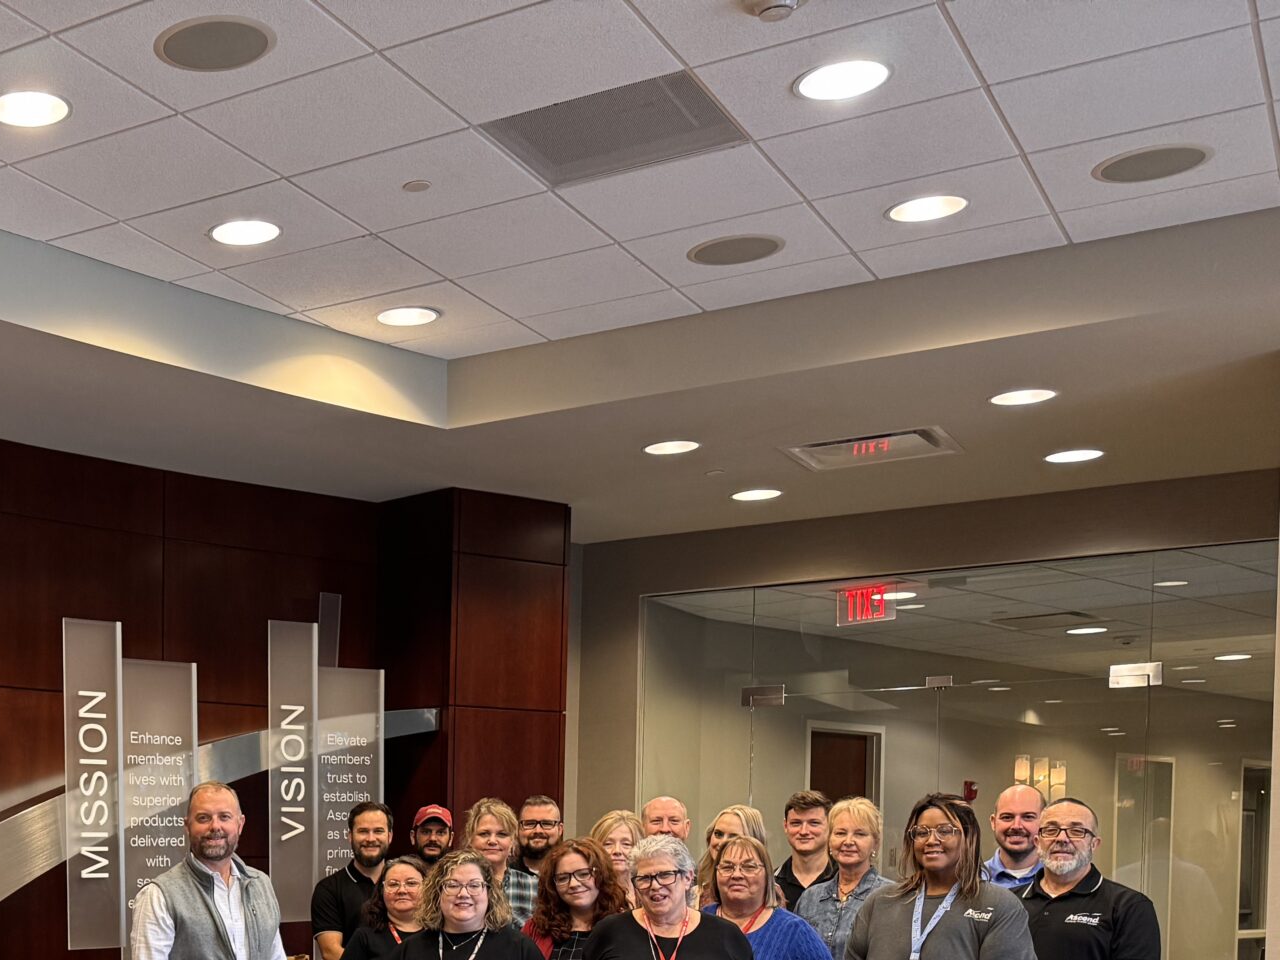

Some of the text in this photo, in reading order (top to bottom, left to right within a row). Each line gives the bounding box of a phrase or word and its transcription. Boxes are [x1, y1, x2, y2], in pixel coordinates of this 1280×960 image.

[130, 731, 182, 745] Enhance
[327, 734, 367, 746] Elevate
[127, 753, 185, 766] members'
[321, 753, 373, 765] members'
[129, 773, 184, 786] lives with
[280, 705, 305, 841] VISION
[326, 772, 367, 783] trust to
[78, 690, 109, 879] MISSION
[132, 794, 181, 808] superior
[323, 791, 371, 802] establish
[130, 814, 185, 828] products
[326, 809, 350, 820] Asc
[130, 834, 185, 847] delivered
[327, 830, 340, 840] as
[146, 854, 171, 867] with
[1065, 914, 1099, 923] Ascend
